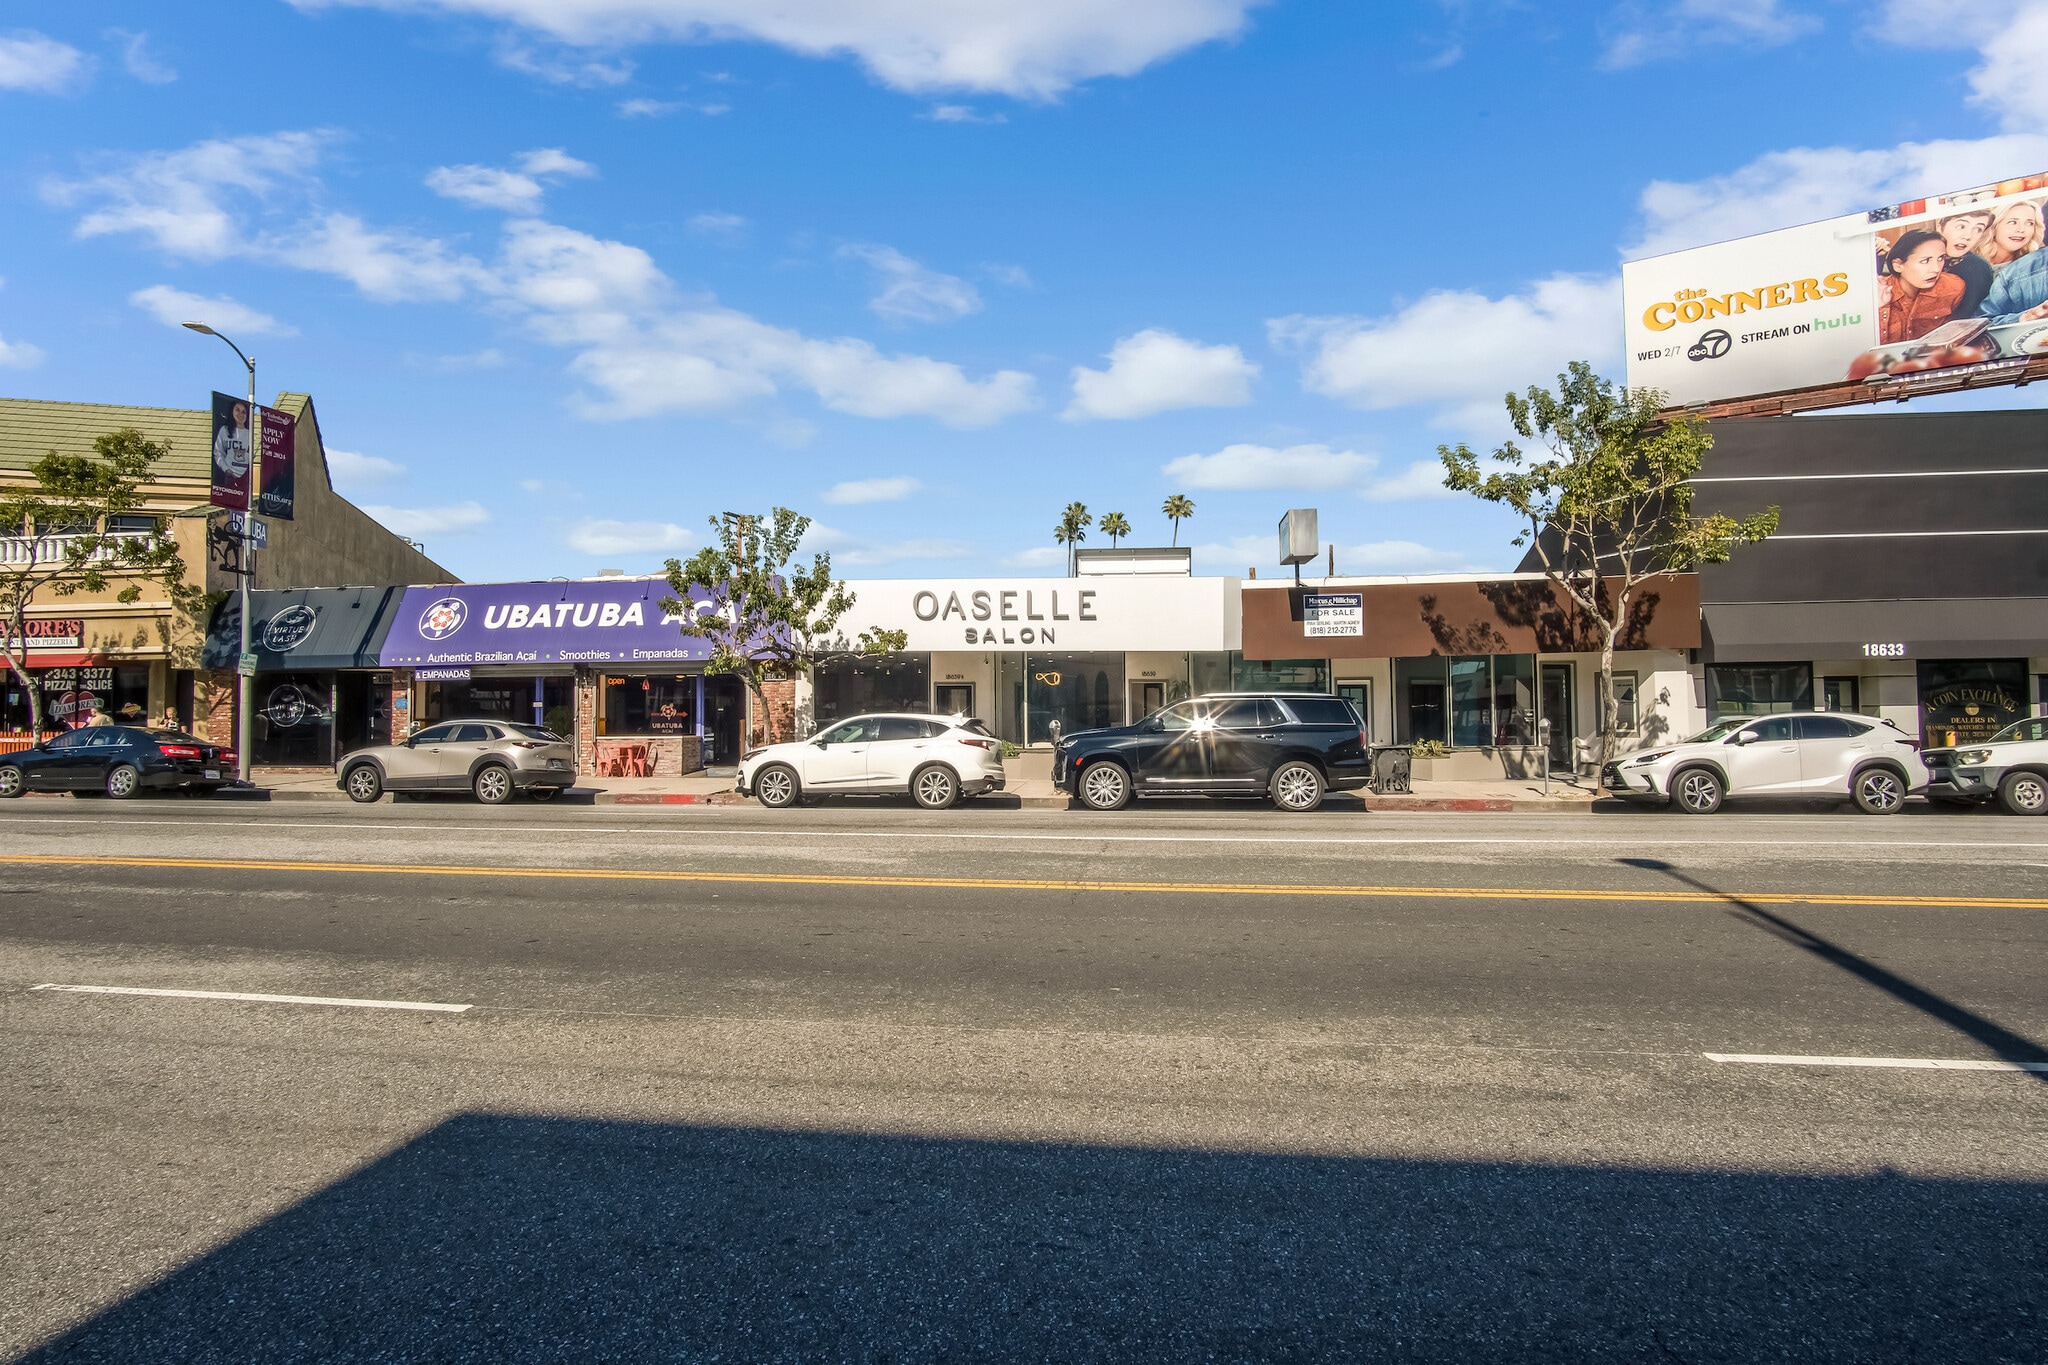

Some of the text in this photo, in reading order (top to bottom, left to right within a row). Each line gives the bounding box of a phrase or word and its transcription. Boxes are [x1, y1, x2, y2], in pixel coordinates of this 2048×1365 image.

[1674, 288, 1707, 301] the
[1643, 272, 1849, 332] CONNERS
[1741, 313, 1862, 344] STREAM ON hulu
[1638, 346, 1682, 361] WED 2/7
[1689, 349, 1707, 357] abc
[262, 427, 284, 439] APPLY
[263, 435, 280, 445] NOW
[212, 485, 244, 496] PSYCHOLOGY
[912, 590, 1098, 622] OASELLE
[1332, 596, 1358, 605] Millichap
[483, 602, 644, 630] UBATUBA
[1311, 609, 1330, 617] FOR
[273, 625, 305, 634] VIRTUE
[1310, 626, 1357, 635] (818) 212-2776
[272, 635, 297, 643] LASH
[965, 627, 1055, 644] SALON
[42, 638, 73, 646] PIZZERIA
[632, 648, 689, 661] Empanadas
[1862, 643, 1905, 656] 18633
[427, 650, 537, 663] Authentic Brazilian Açaí
[559, 650, 610, 661] Smoothies
[53, 668, 76, 679] 343
[83, 668, 112, 679] 3377
[422, 669, 470, 679] EMPANADAS
[44, 681, 72, 690] PIZZA
[86, 680, 112, 690] SLICE
[607, 678, 625, 686] open
[1926, 689, 2018, 713] A COIN EXCHANGE
